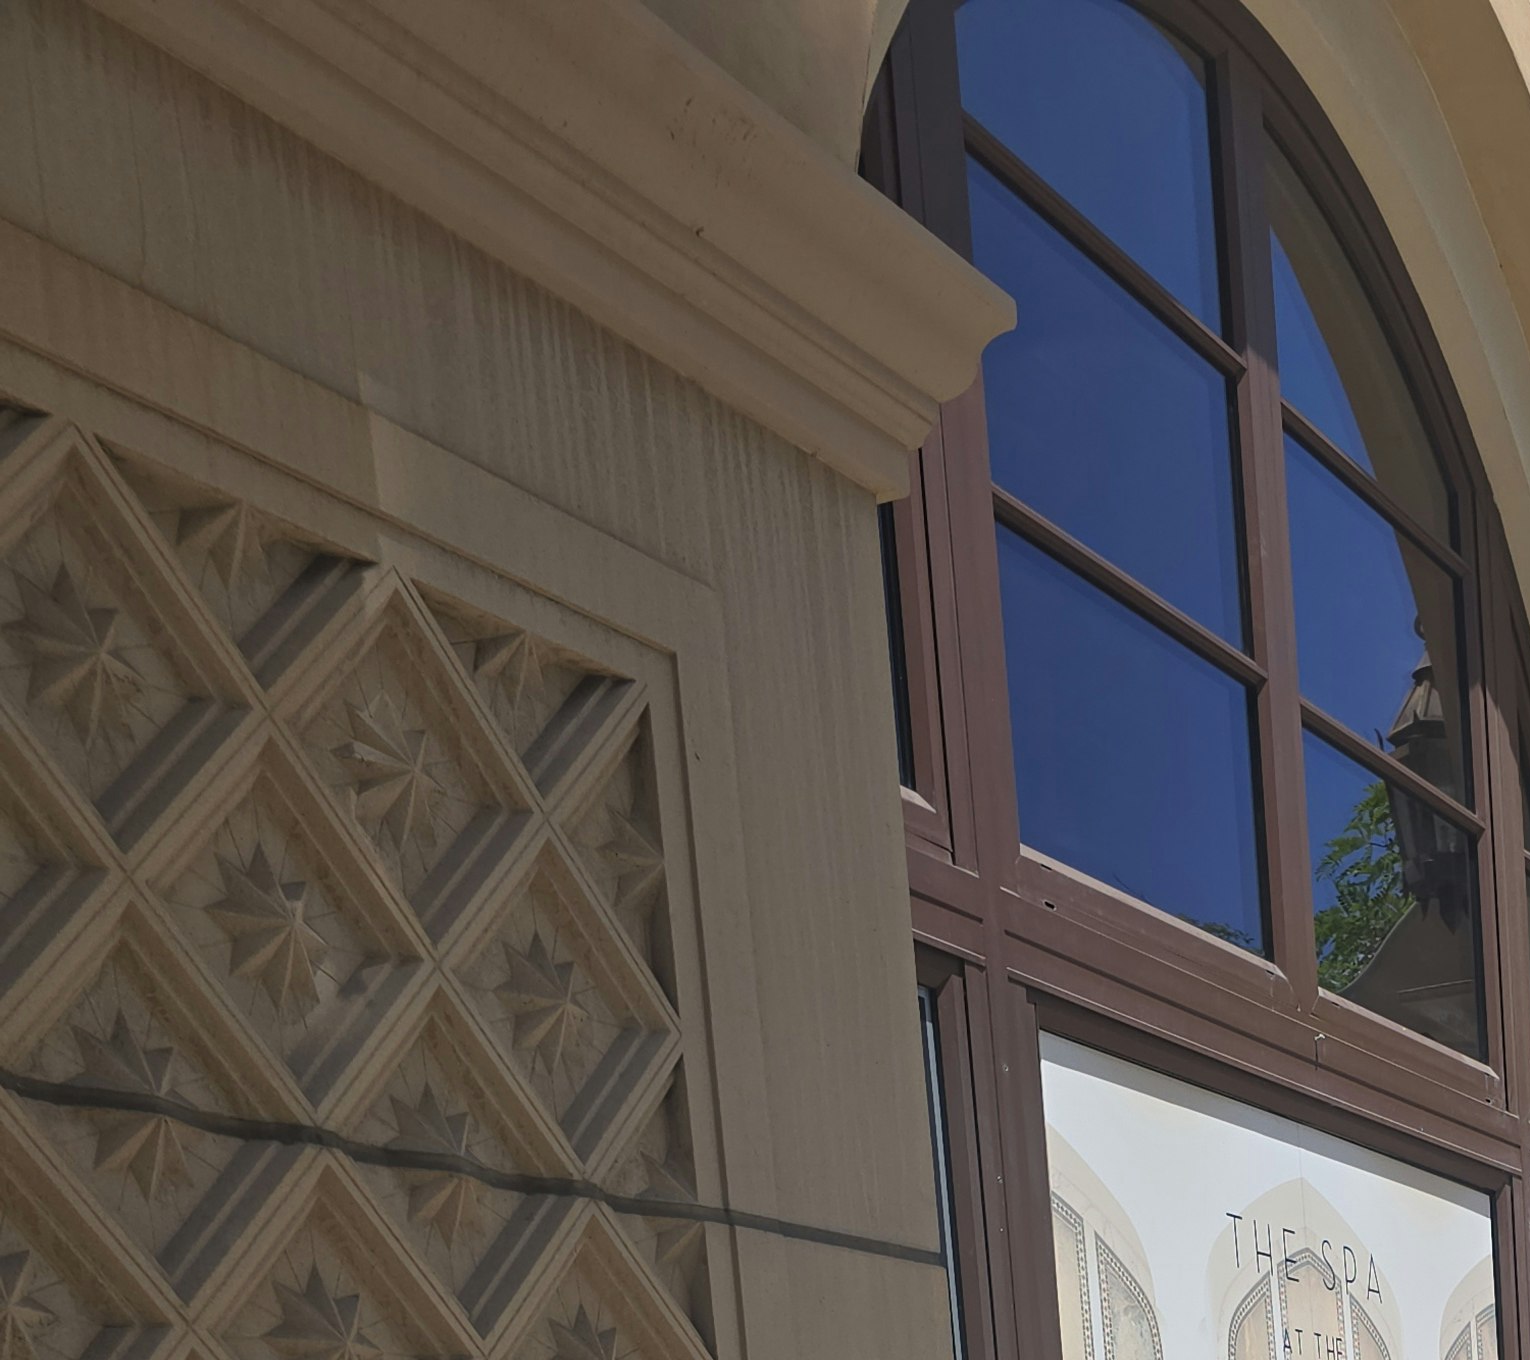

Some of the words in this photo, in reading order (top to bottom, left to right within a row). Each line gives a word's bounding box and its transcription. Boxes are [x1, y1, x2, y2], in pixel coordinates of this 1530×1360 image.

[1225, 1212, 1299, 1283] THE
[1321, 1239, 1383, 1304] SPA
[1283, 1328, 1304, 1355] AT
